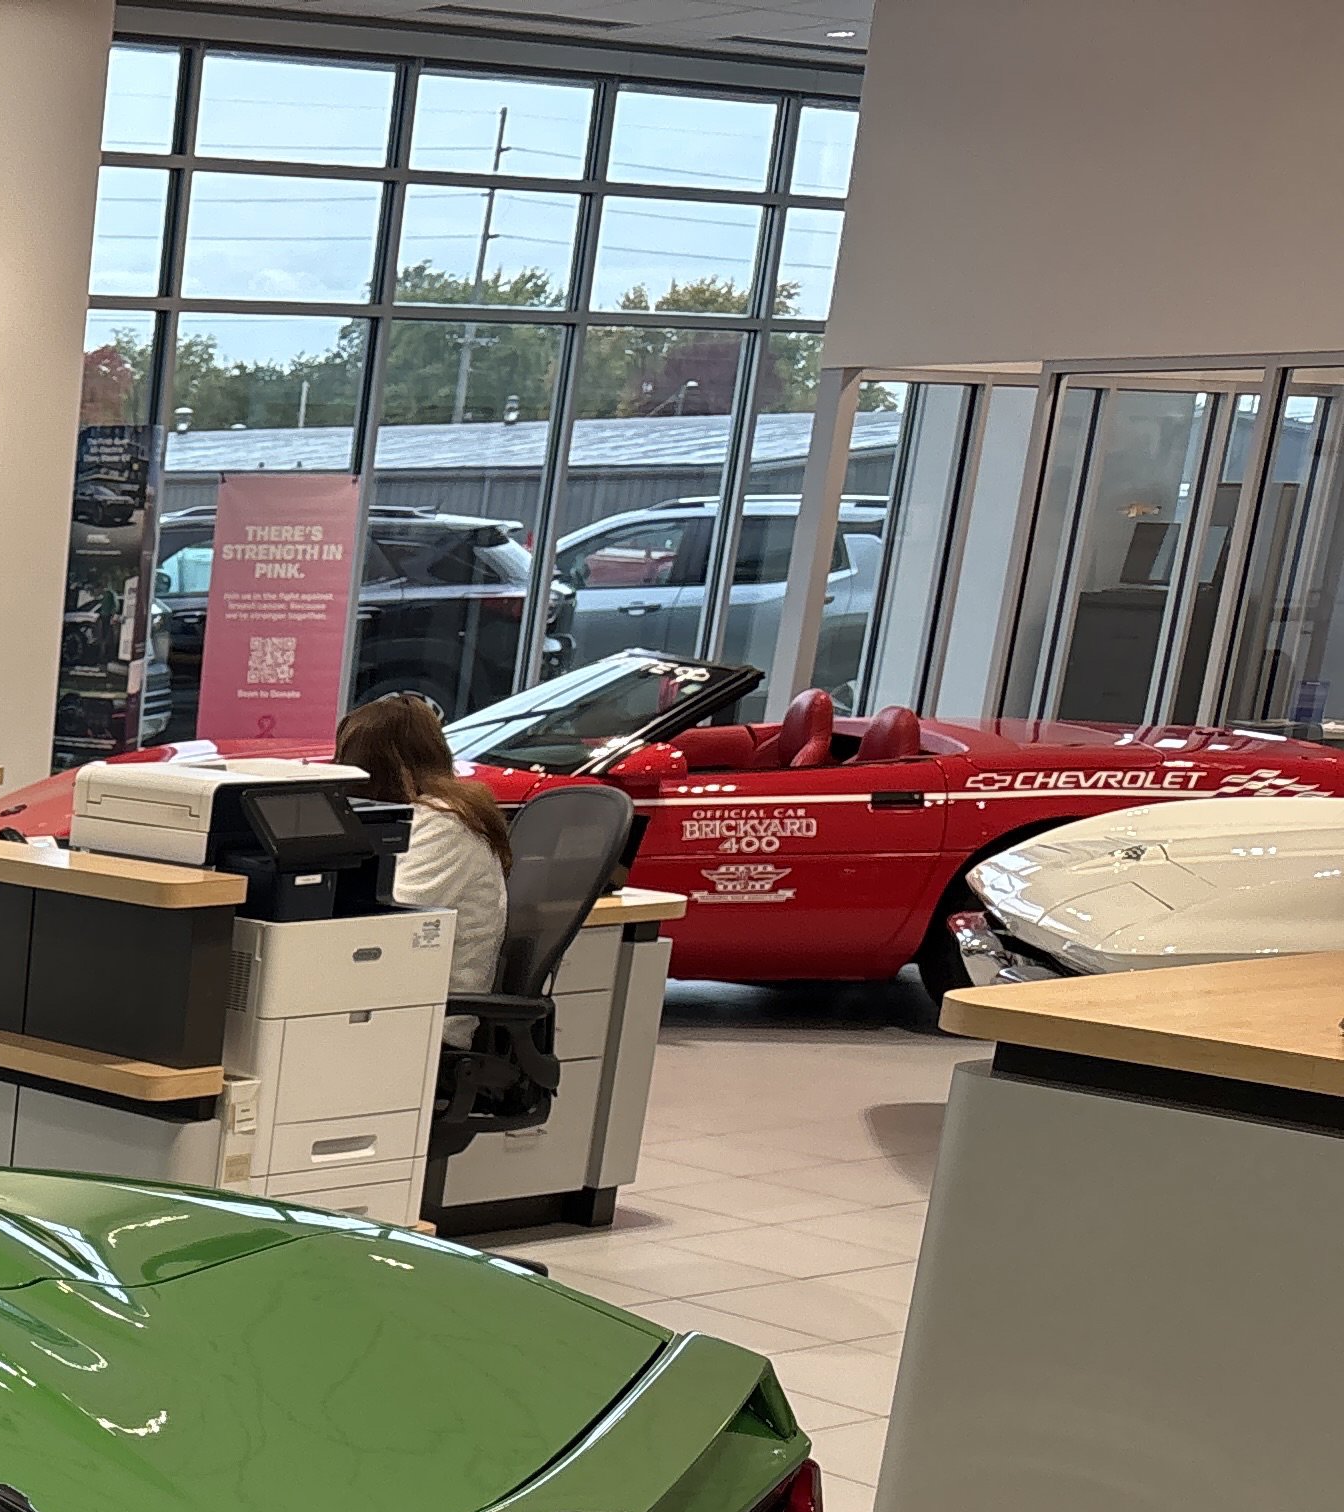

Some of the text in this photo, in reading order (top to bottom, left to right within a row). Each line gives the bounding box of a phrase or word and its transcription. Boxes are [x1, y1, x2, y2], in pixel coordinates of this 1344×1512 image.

[245, 525, 324, 542] THERE'S
[221, 543, 343, 561] STRENGTH IN
[254, 562, 306, 579] PINK.
[1013, 770, 1208, 790] CHEVROLET
[692, 807, 806, 819] OFFICIAL CAR
[681, 817, 818, 841] BRICKYARD
[717, 836, 781, 853] 400
